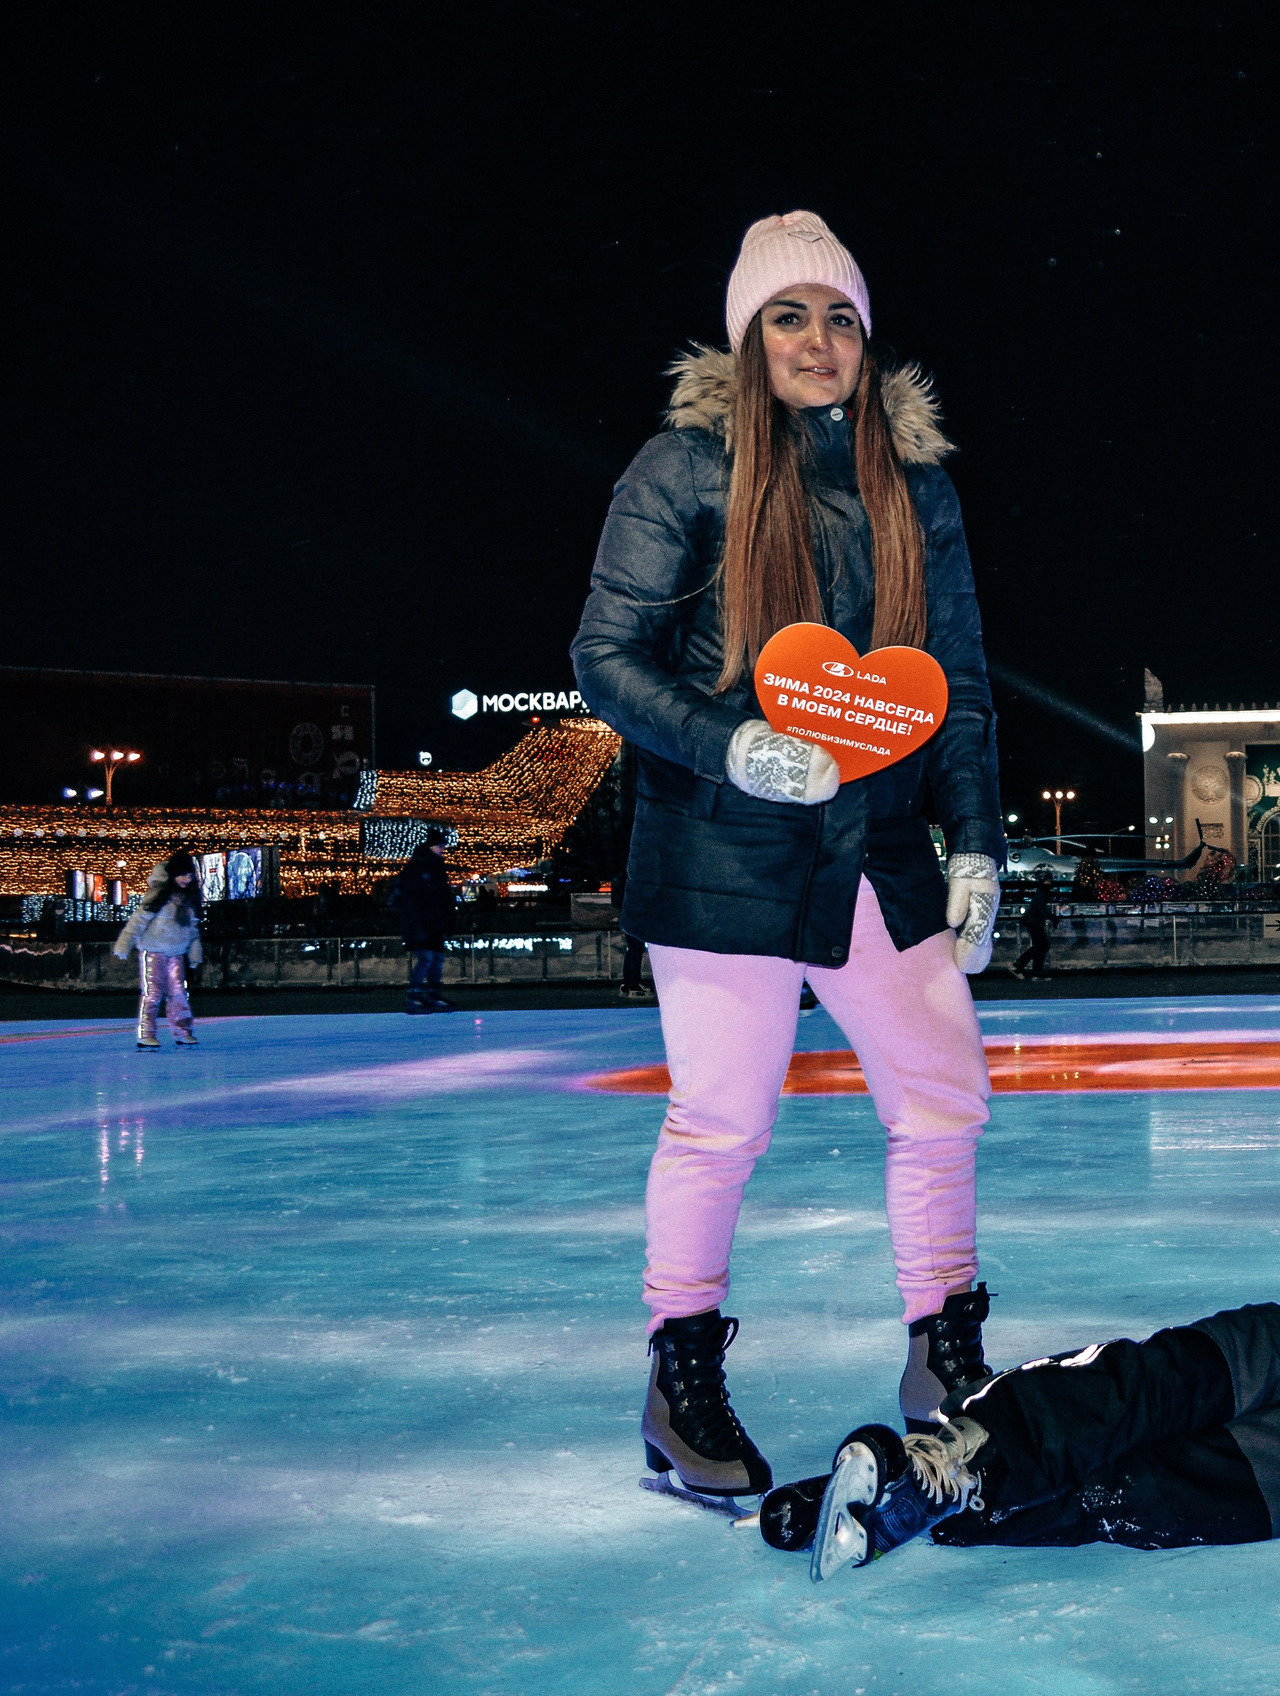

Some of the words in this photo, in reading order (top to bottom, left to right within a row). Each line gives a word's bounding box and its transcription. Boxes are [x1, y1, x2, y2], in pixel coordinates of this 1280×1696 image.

[856, 671, 887, 685] LADA
[763, 673, 810, 694] ЗИМА
[813, 685, 851, 704] 2024
[854, 695, 935, 724] НАВСЕГДА
[777, 694, 788, 706] В
[791, 697, 842, 719] МОЕМ
[844, 710, 913, 735] СЕРДЦЕ!
[786, 726, 891, 756] #ПОЛЮБИЗИМУСЛАДА
